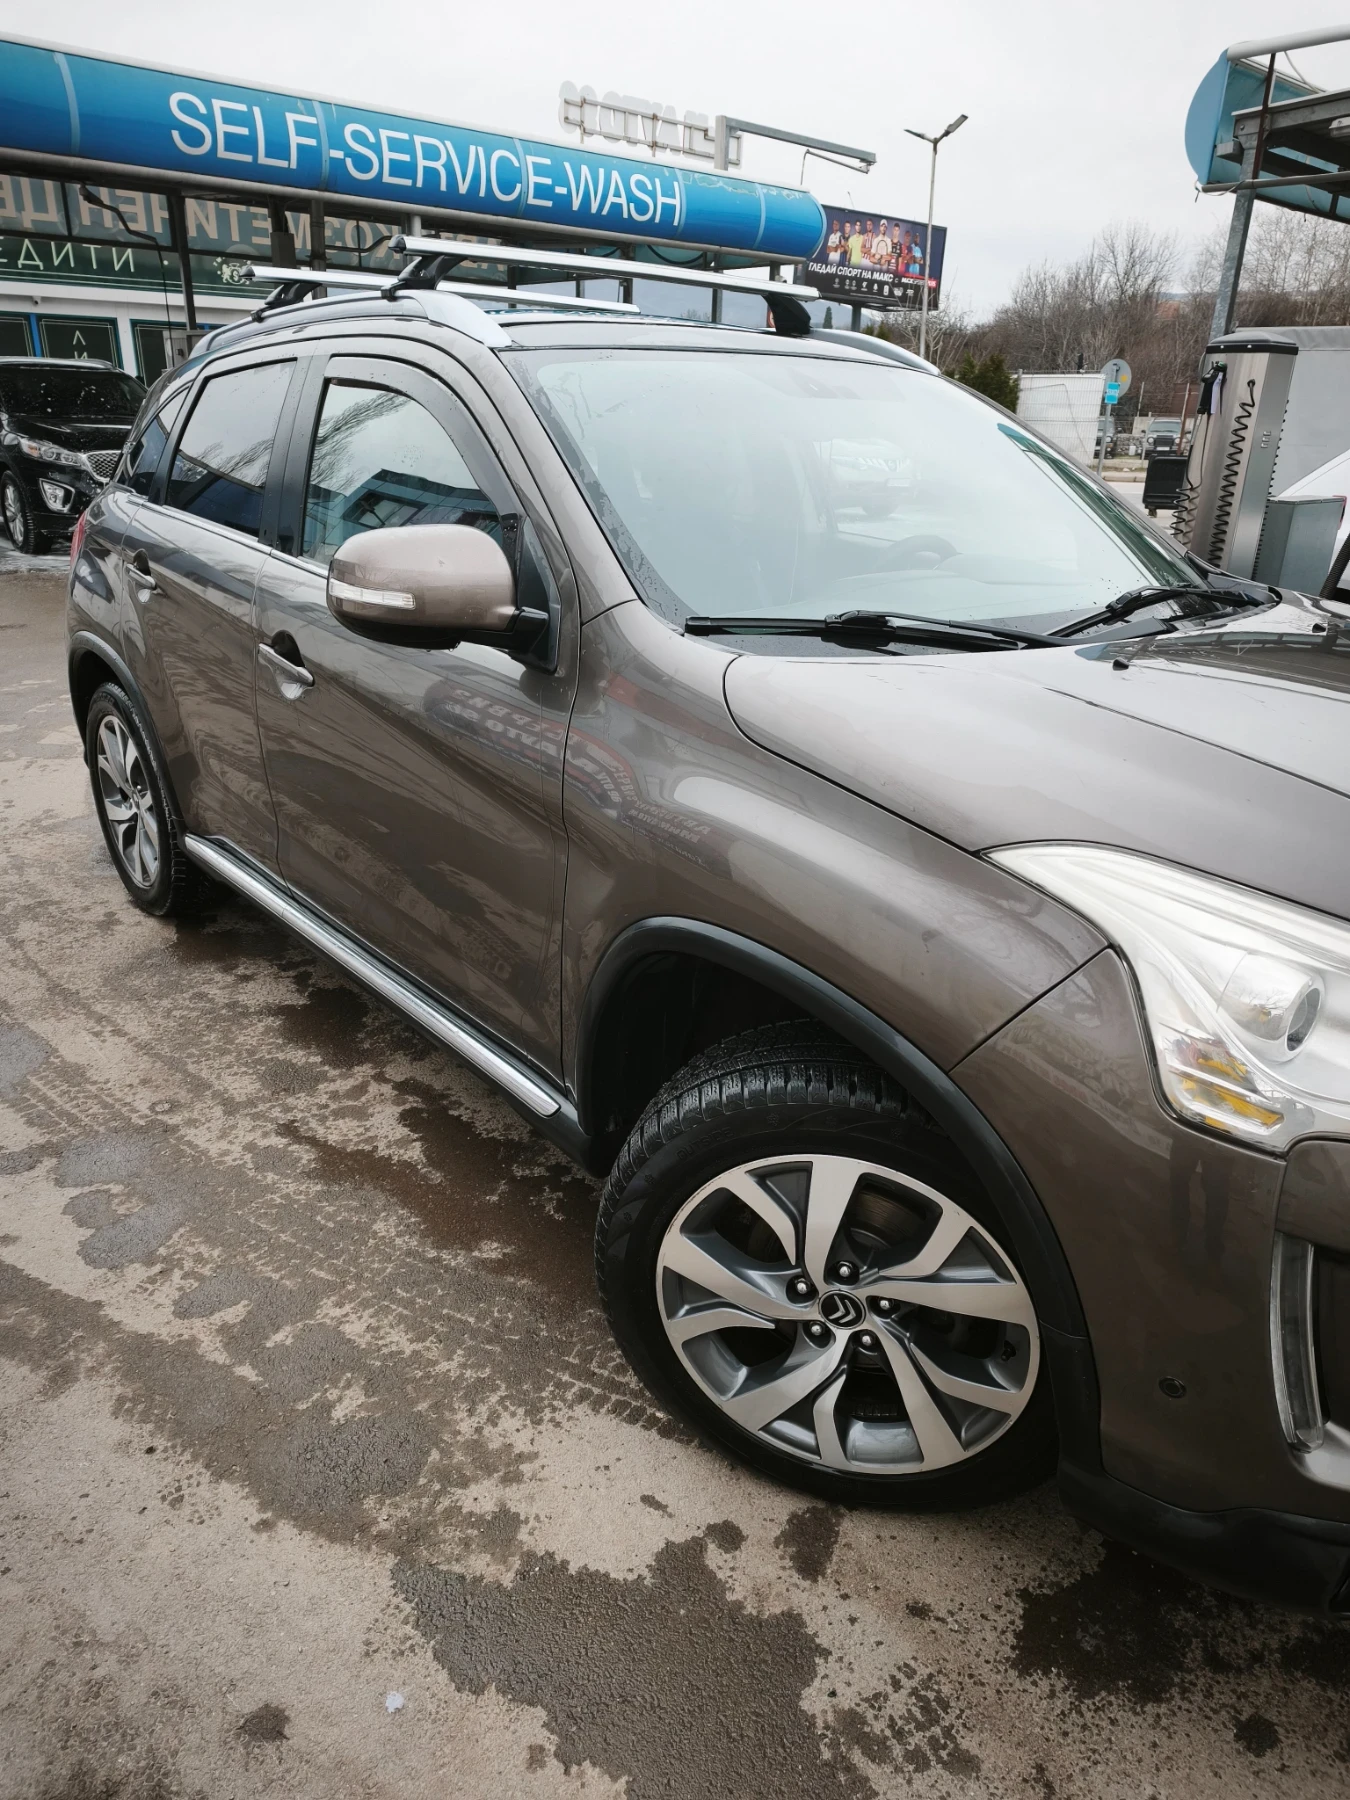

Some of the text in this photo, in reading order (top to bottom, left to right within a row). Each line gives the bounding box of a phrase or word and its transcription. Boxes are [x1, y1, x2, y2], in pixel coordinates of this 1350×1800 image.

[808, 262, 837, 274] ГЛЕДАЙ
[837, 266, 862, 278] СПОРТ
[861, 270, 872, 279] НА
[872, 272, 894, 282] МАКС
[677, 1127, 734, 1160] OUTSIDE
